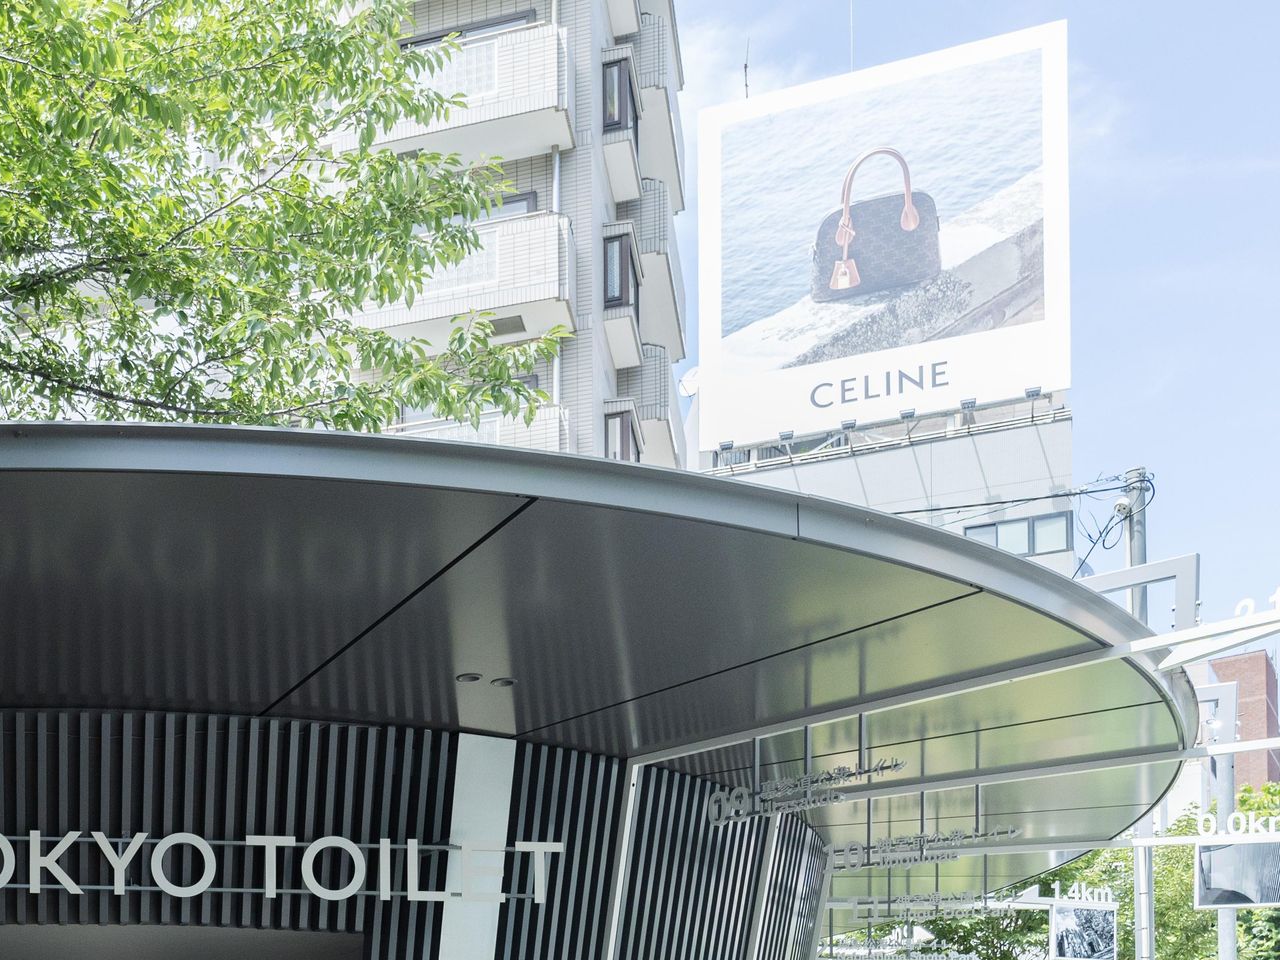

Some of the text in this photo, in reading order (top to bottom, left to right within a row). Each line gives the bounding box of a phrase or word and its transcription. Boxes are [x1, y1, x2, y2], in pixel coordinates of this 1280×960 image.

[810, 361, 949, 408] CELINE
[708, 786, 751, 826] 09
[1198, 811, 1280, 836] 0.0k
[245, 835, 565, 904] TOILET
[1051, 881, 1114, 902] 1.4km
